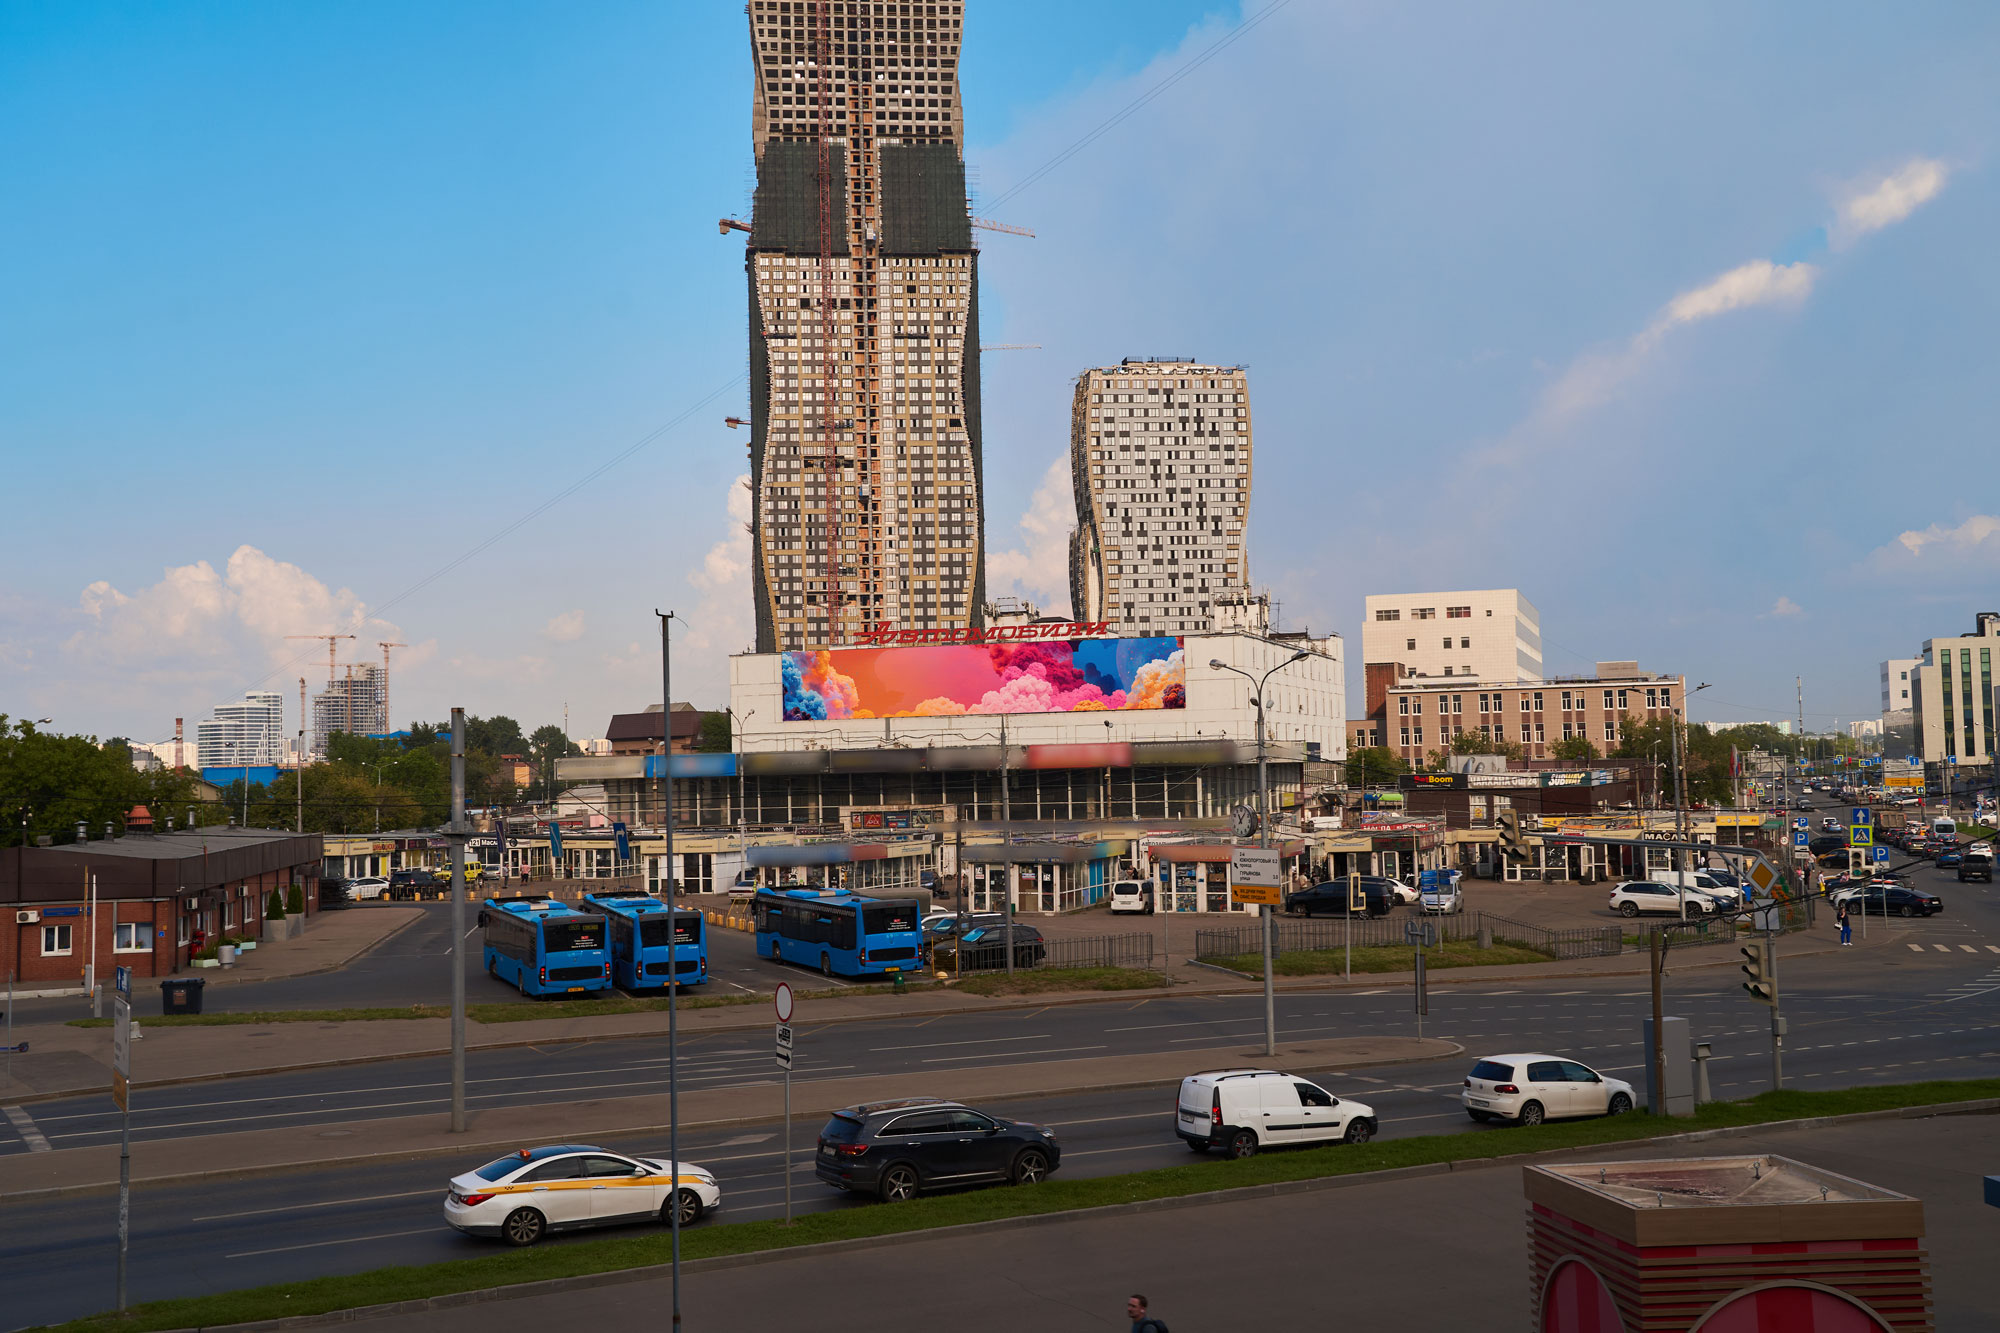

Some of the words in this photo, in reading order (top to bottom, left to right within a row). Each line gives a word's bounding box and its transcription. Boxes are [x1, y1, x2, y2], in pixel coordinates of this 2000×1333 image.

[1527, 777, 1538, 786] 24
[1548, 773, 1586, 786] SUBWAY
[1645, 833, 1687, 841] МАСЛА
